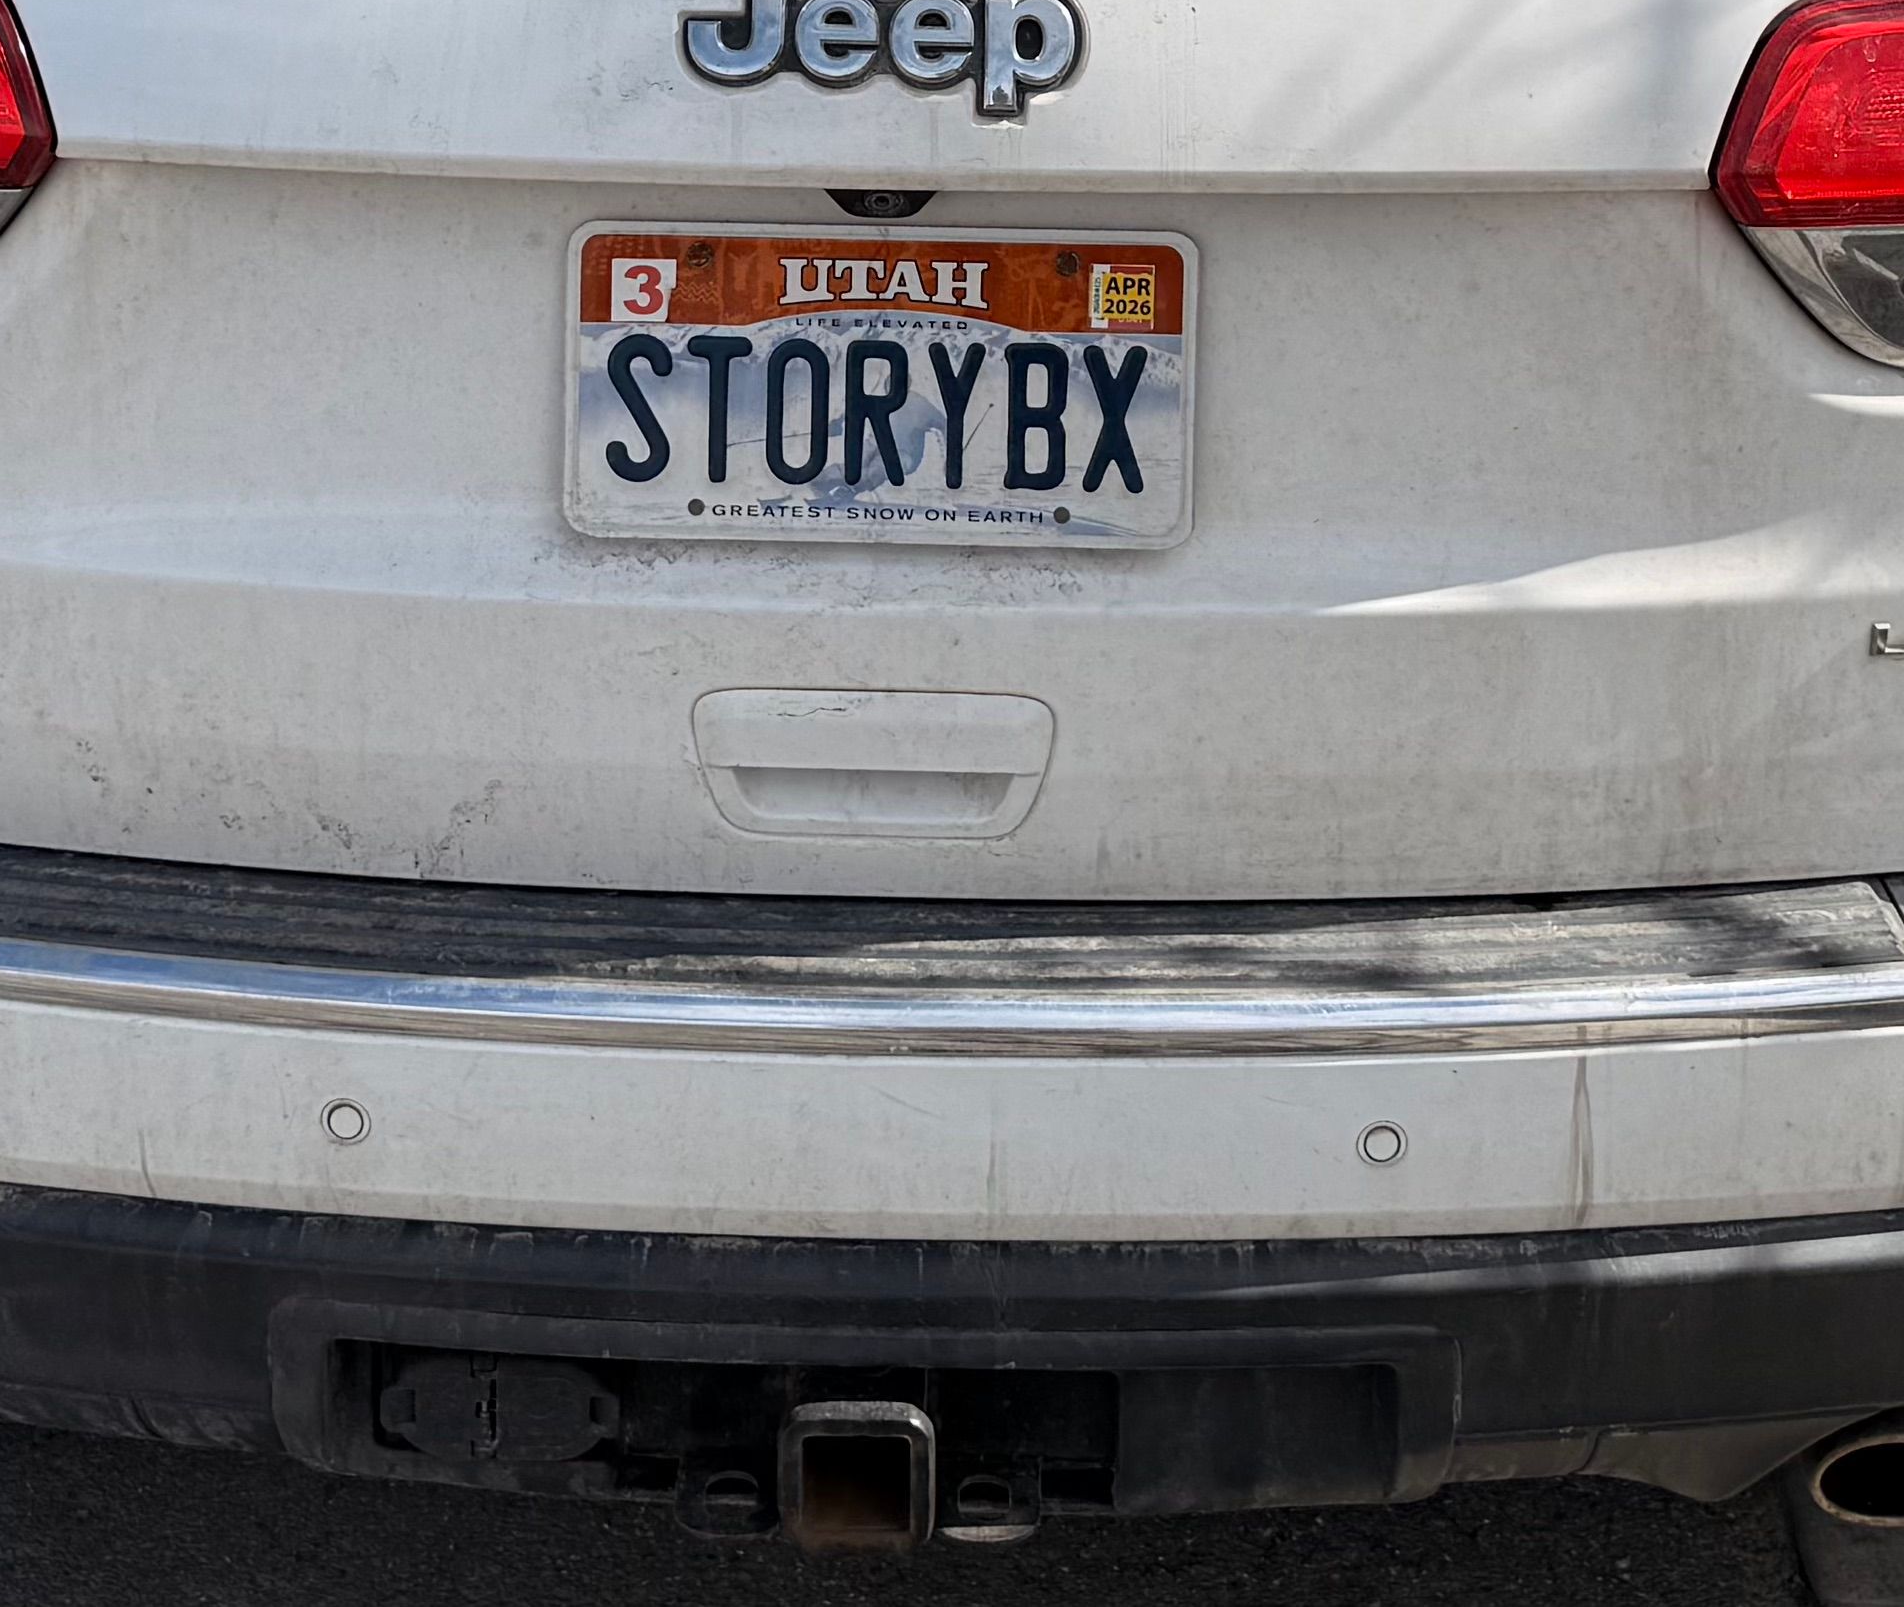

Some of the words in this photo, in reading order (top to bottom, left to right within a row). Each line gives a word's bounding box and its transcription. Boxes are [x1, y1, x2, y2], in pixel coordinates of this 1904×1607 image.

[623, 265, 663, 314] 3
[778, 257, 989, 310] UTAH
[1106, 277, 1150, 296] APR
[1103, 299, 1151, 315] 2026
[795, 317, 841, 327] LIFE
[854, 317, 969, 330] ELEVATED
[606, 334, 1148, 493] STORYBX
[711, 503, 835, 518] GREATEST
[846, 506, 914, 521] SNOW
[924, 508, 957, 522] ON
[967, 510, 1044, 523] EARTH
